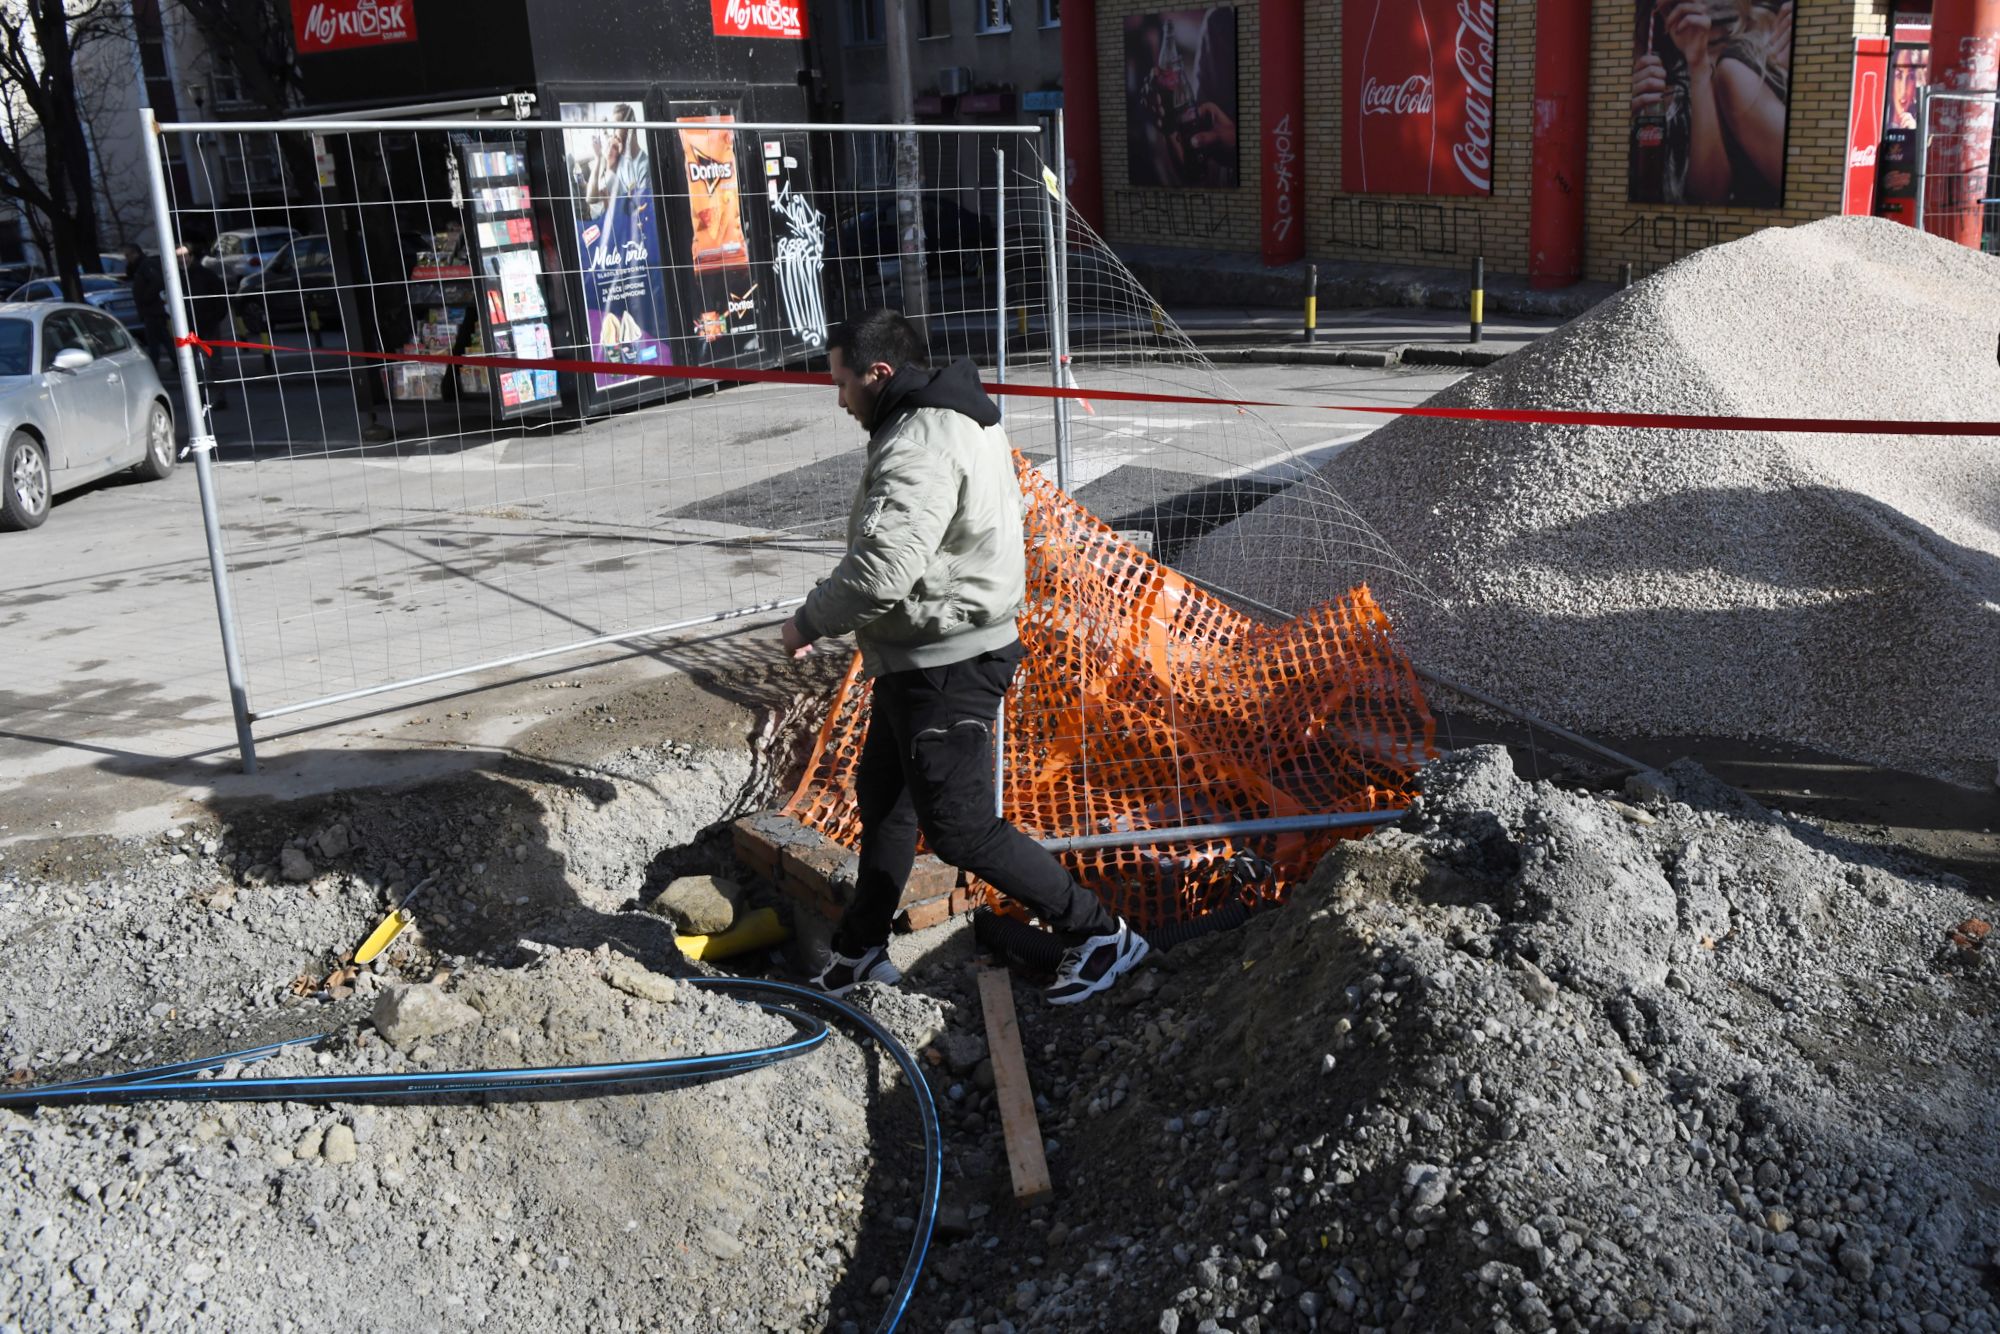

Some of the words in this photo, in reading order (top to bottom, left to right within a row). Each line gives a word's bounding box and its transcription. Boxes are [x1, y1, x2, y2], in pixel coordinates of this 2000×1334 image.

[304, 3, 336, 44] Moj
[338, 4, 406, 37] KIOSK
[724, 0, 751, 30] Moj
[751, 4, 800, 29] KIOSK
[1363, 75, 1433, 115] Coca-Cola
[689, 162, 732, 181] Doritos
[588, 246, 621, 271] Male
[729, 300, 754, 312] Doritos
